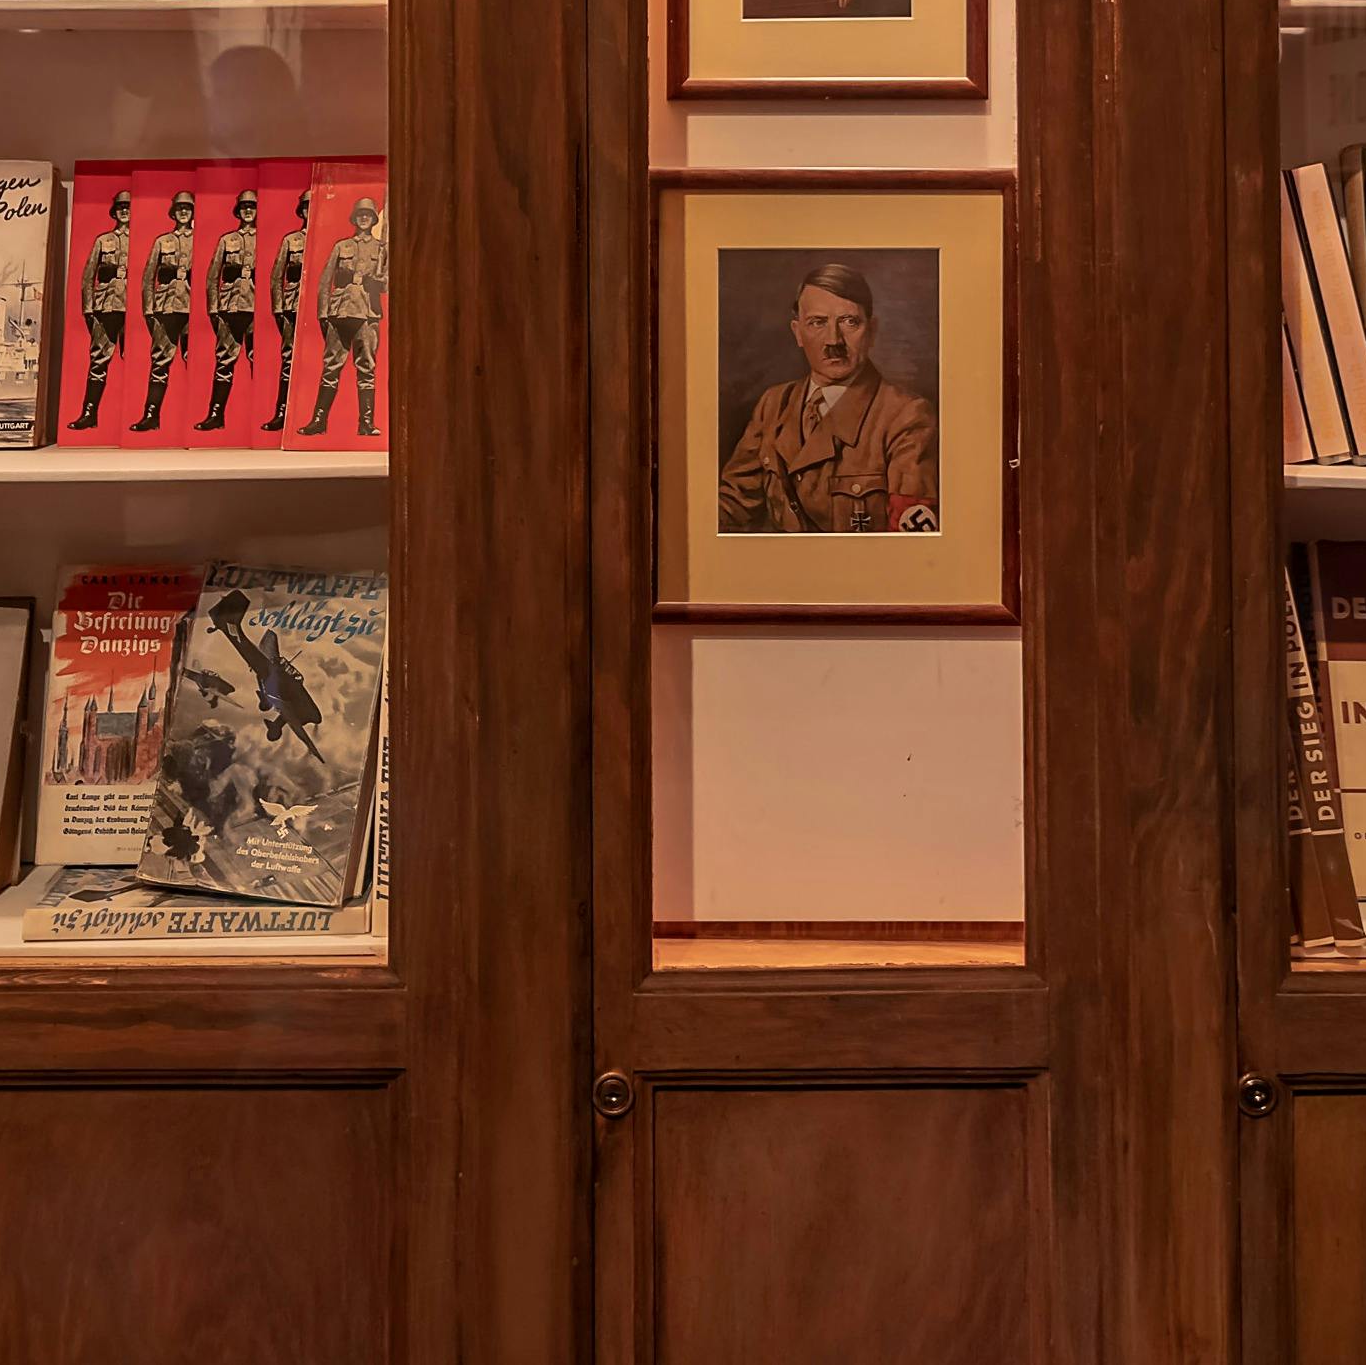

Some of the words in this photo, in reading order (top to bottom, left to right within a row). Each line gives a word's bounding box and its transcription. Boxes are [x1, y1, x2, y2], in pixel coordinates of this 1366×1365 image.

[207, 563, 384, 600] LUFTWAFFE
[107, 591, 143, 609] Die
[248, 600, 346, 642] schlägt
[80, 635, 161, 656] Danzigs
[1296, 700, 1324, 763] SIEG
[1310, 769, 1336, 822] DER
[83, 909, 165, 935] schlägt
[167, 911, 333, 933] LUFTWAFFE
